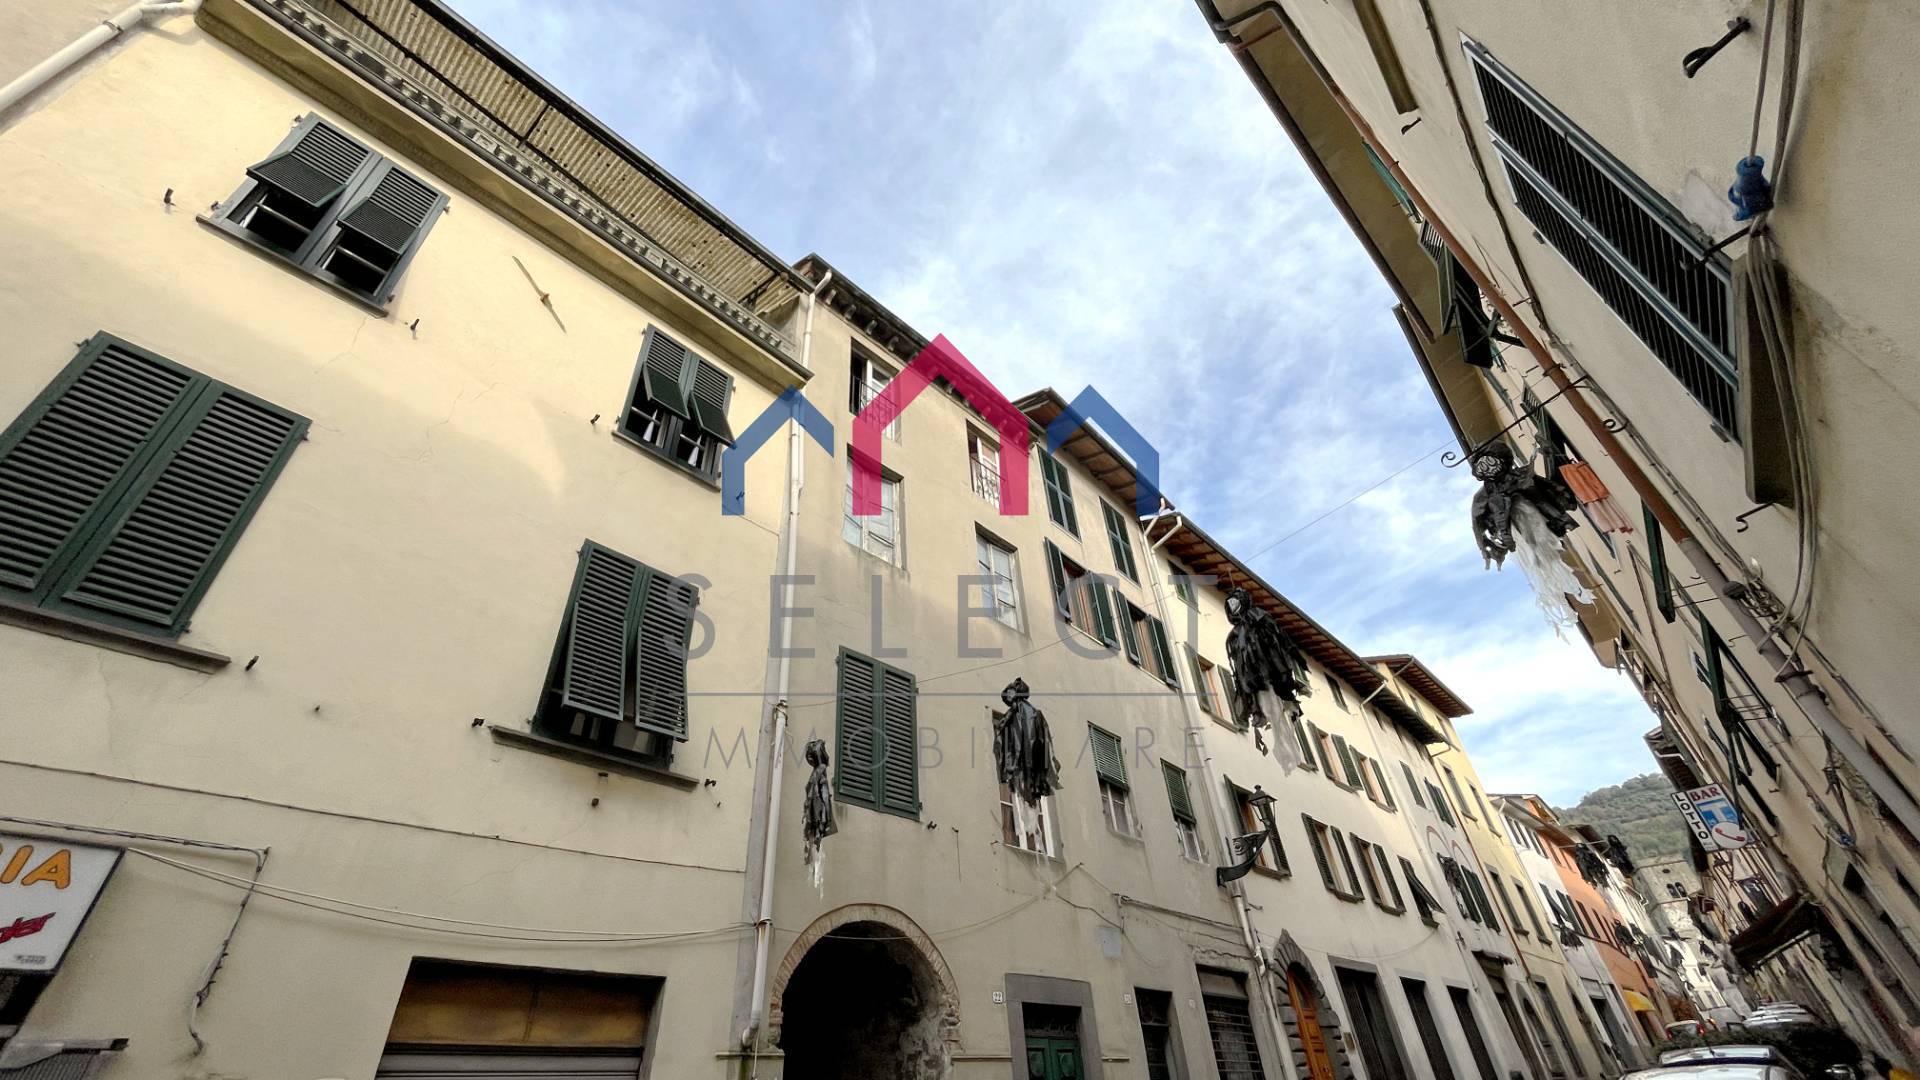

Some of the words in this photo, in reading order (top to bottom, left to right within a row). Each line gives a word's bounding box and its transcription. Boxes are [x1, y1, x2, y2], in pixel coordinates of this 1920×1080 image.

[1675, 794, 1709, 839] LOTTO
[1690, 787, 1720, 801] BAR
[0, 844, 71, 889] IA
